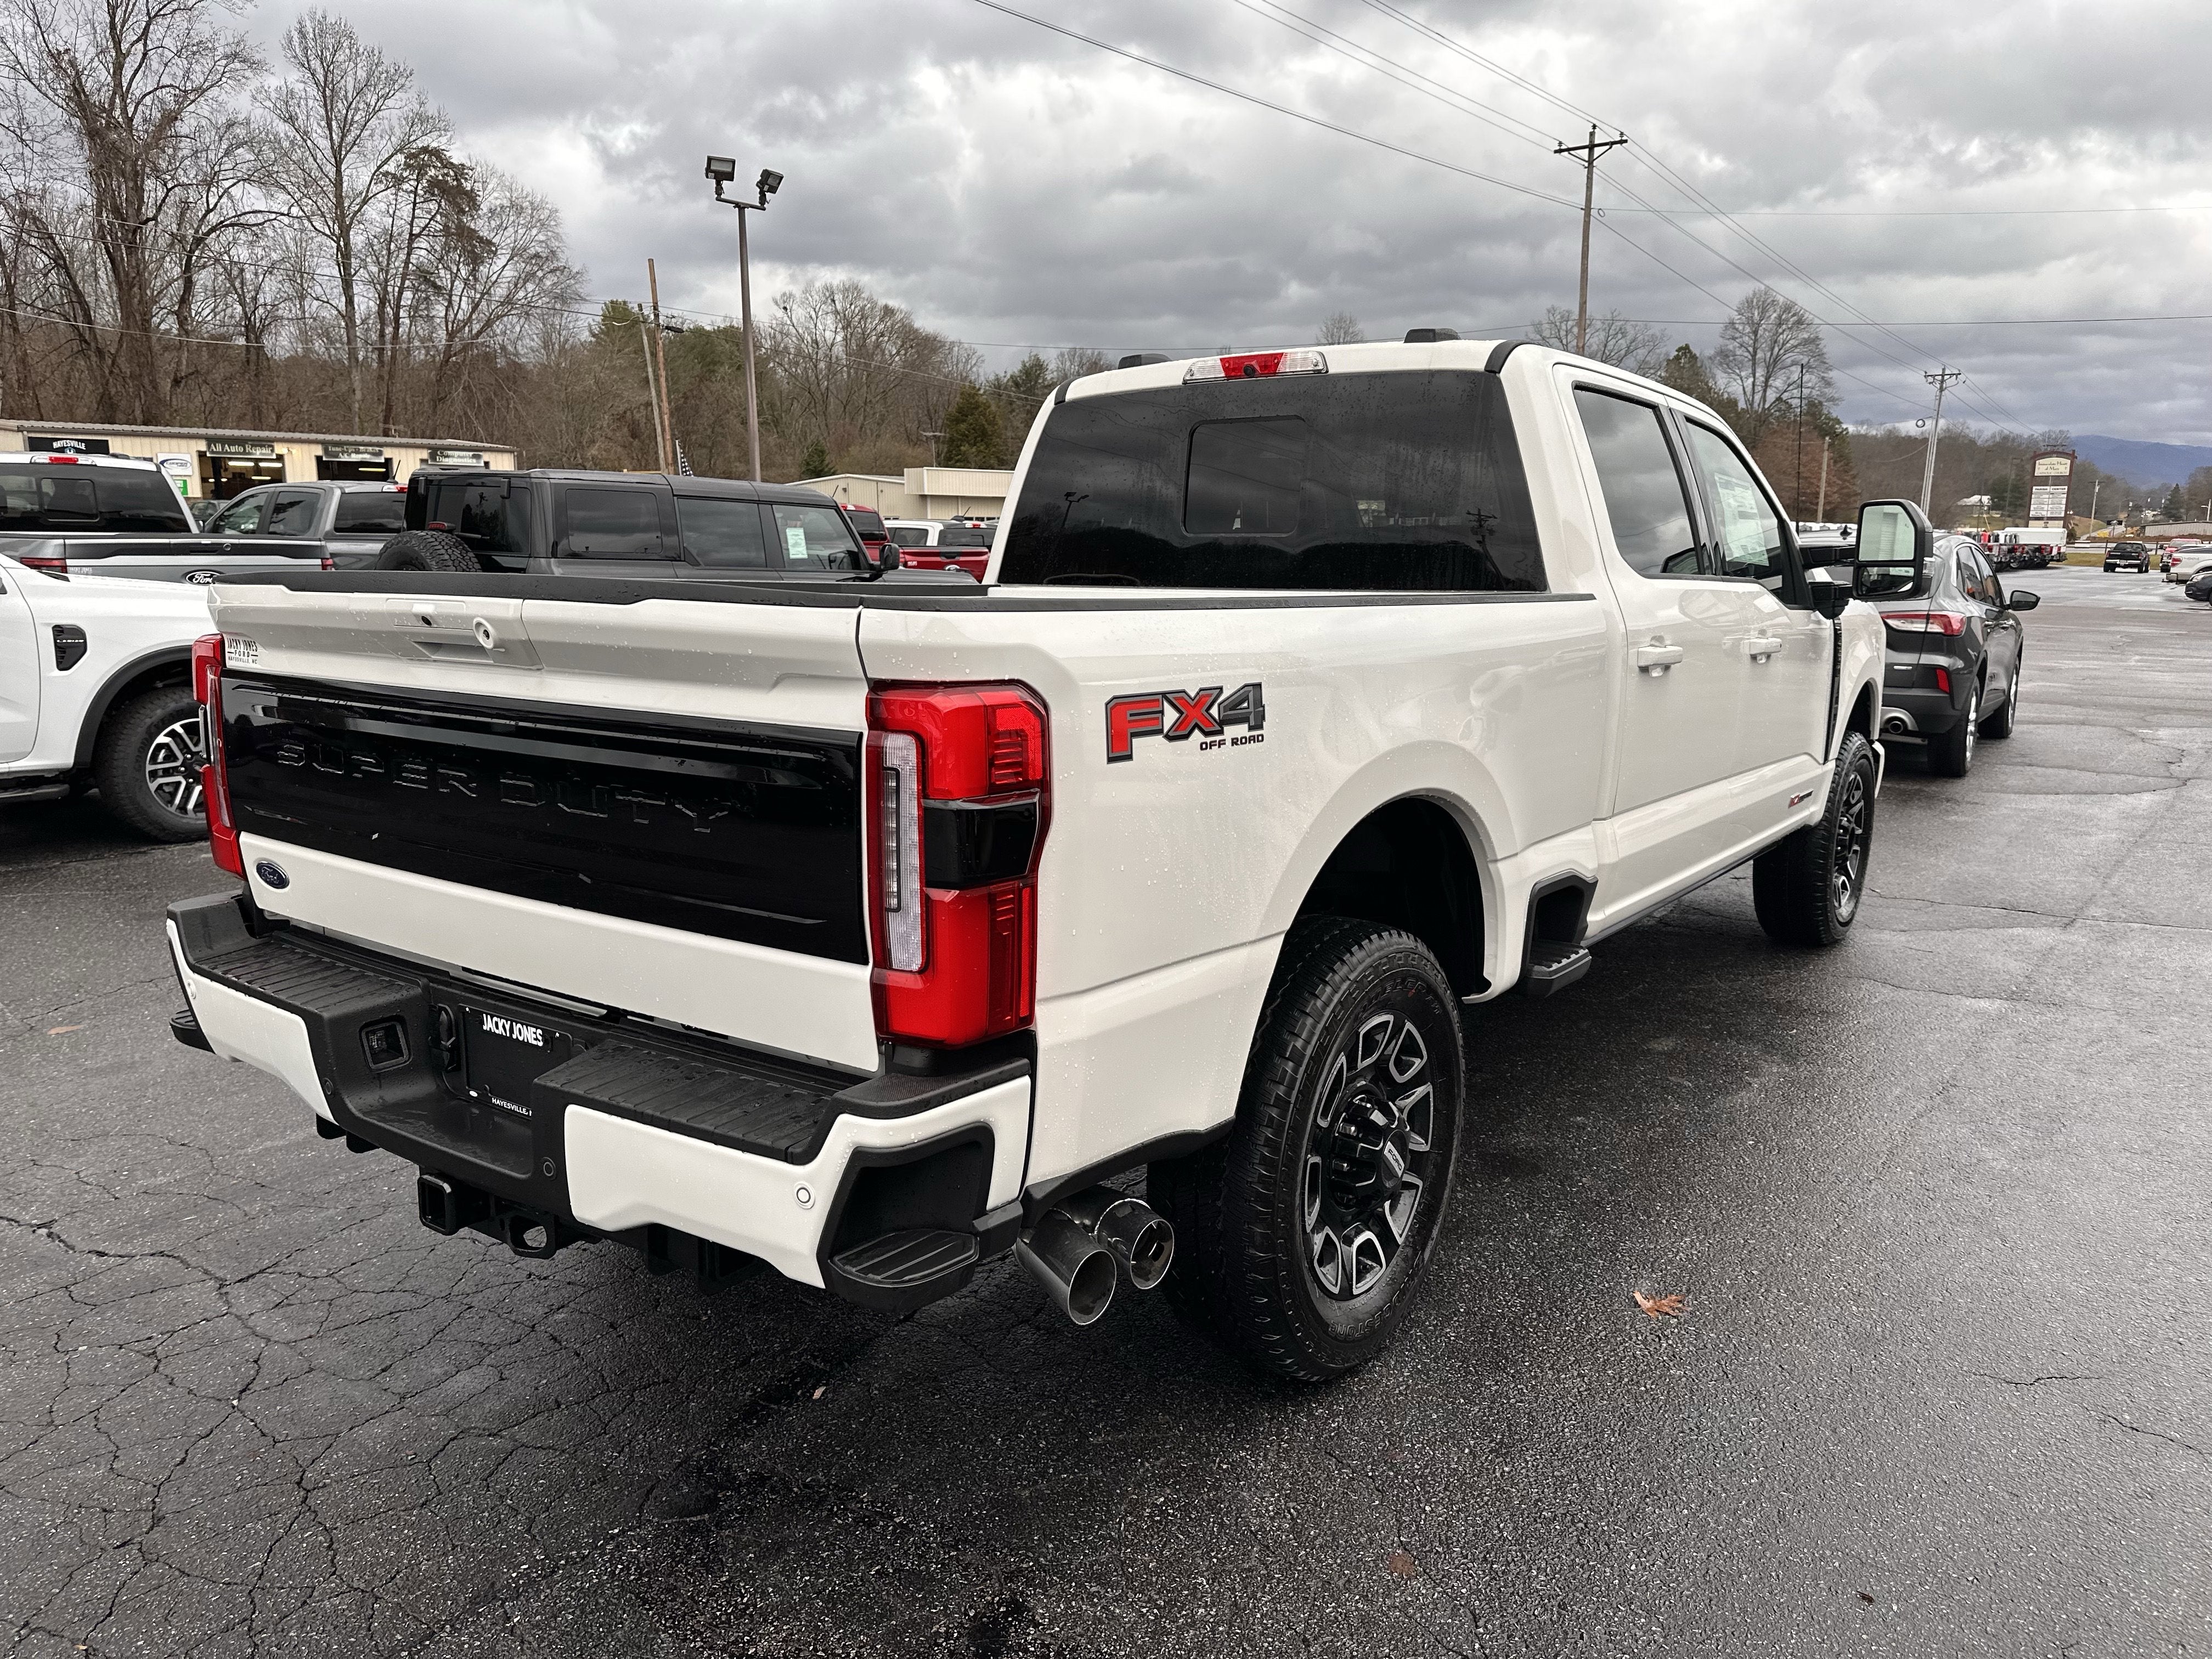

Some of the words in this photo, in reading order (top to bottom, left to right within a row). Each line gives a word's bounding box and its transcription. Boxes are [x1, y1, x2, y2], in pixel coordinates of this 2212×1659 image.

[53, 440, 86, 450] HAYESVILLE
[209, 443, 222, 452] All
[223, 443, 244, 453] Auto
[245, 444, 273, 455] Repair
[227, 637, 241, 650] JACKY
[241, 640, 258, 652] JONES
[1104, 682, 1266, 764] FX4
[1199, 738, 1226, 751] OFF
[1231, 733, 1265, 747] ROAD
[274, 738, 479, 798] SUPER
[498, 771, 732, 834] DUTY
[483, 1013, 511, 1037] JACKY
[512, 1022, 544, 1047] JONES
[492, 1097, 528, 1115] HAYESVILLE,
[1388, 1148, 1402, 1171] FORD
